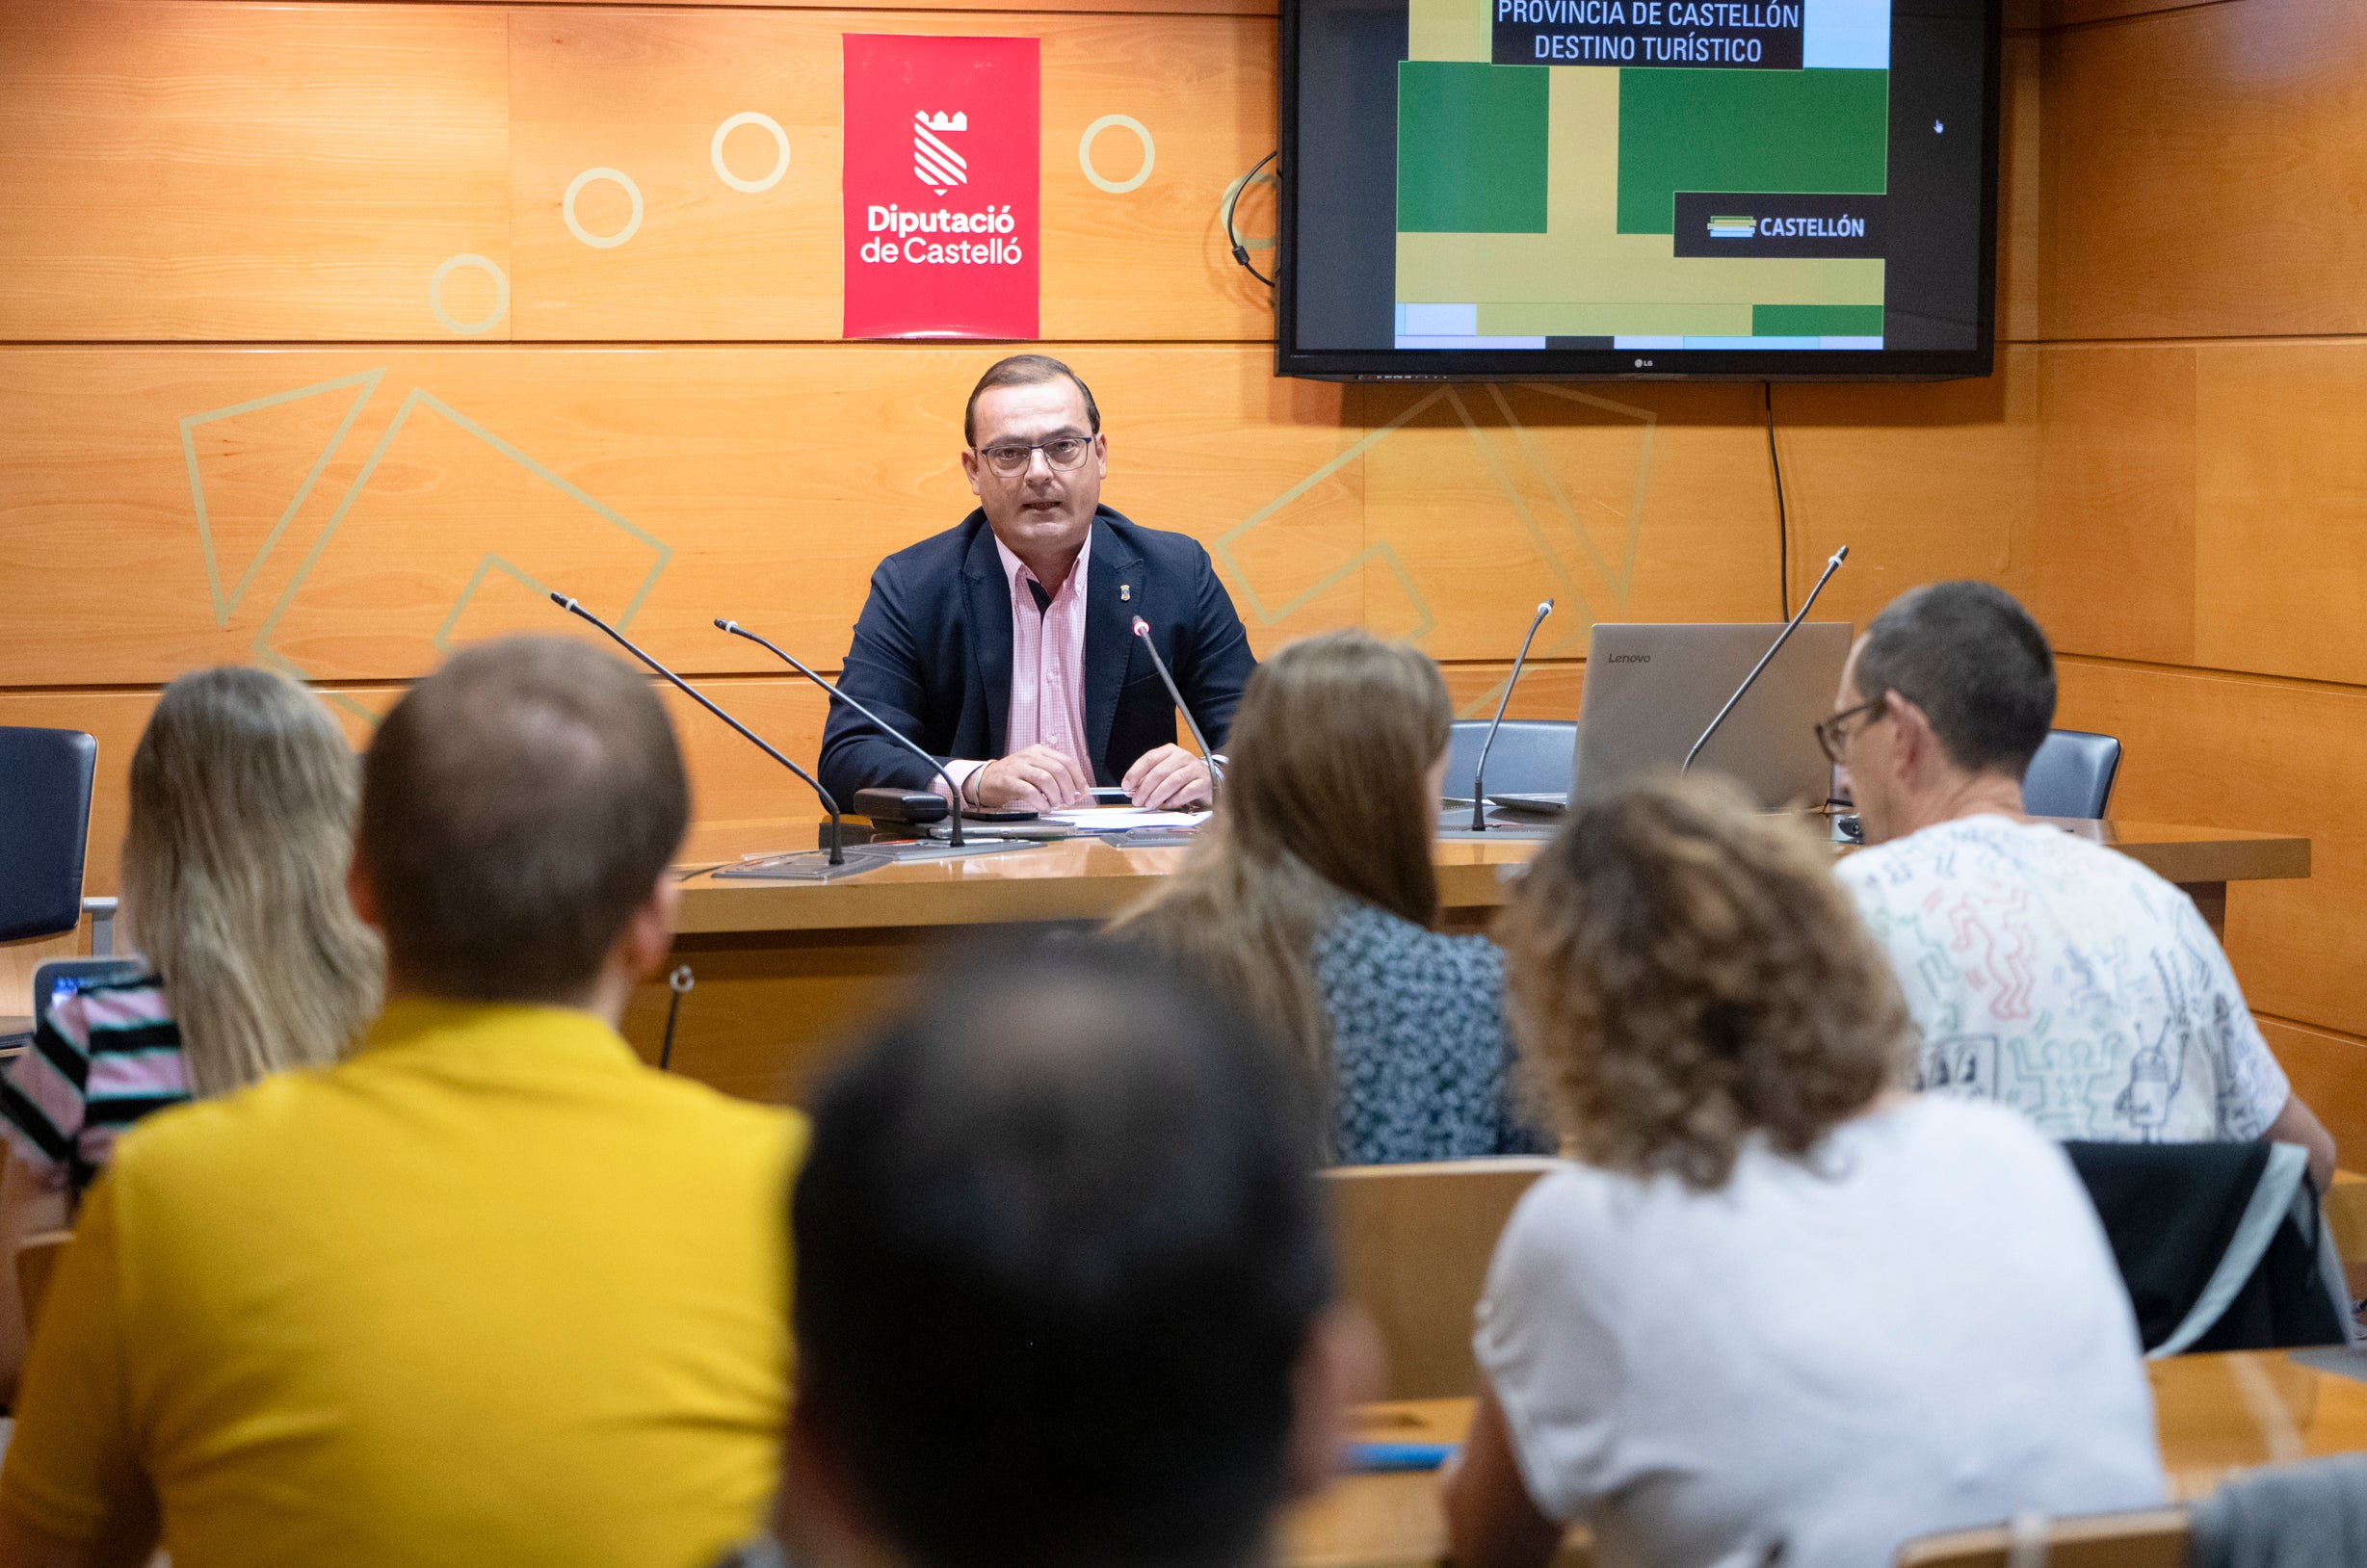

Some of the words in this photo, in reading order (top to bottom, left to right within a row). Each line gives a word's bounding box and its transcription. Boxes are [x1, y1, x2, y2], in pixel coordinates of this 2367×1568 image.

[1497, 0, 1626, 25] PROVINCIA
[1632, 1, 1662, 26] DE
[1668, 0, 1800, 29] CASTELLÓN
[1535, 35, 1636, 61] DESTINO
[1642, 32, 1762, 63] TURÍSTICO
[867, 203, 1015, 239] Diputació
[1760, 214, 1865, 238] CASTELLÓN
[860, 236, 899, 263] de
[903, 236, 1022, 265] Castelló
[1608, 653, 1651, 664] Lenovo
